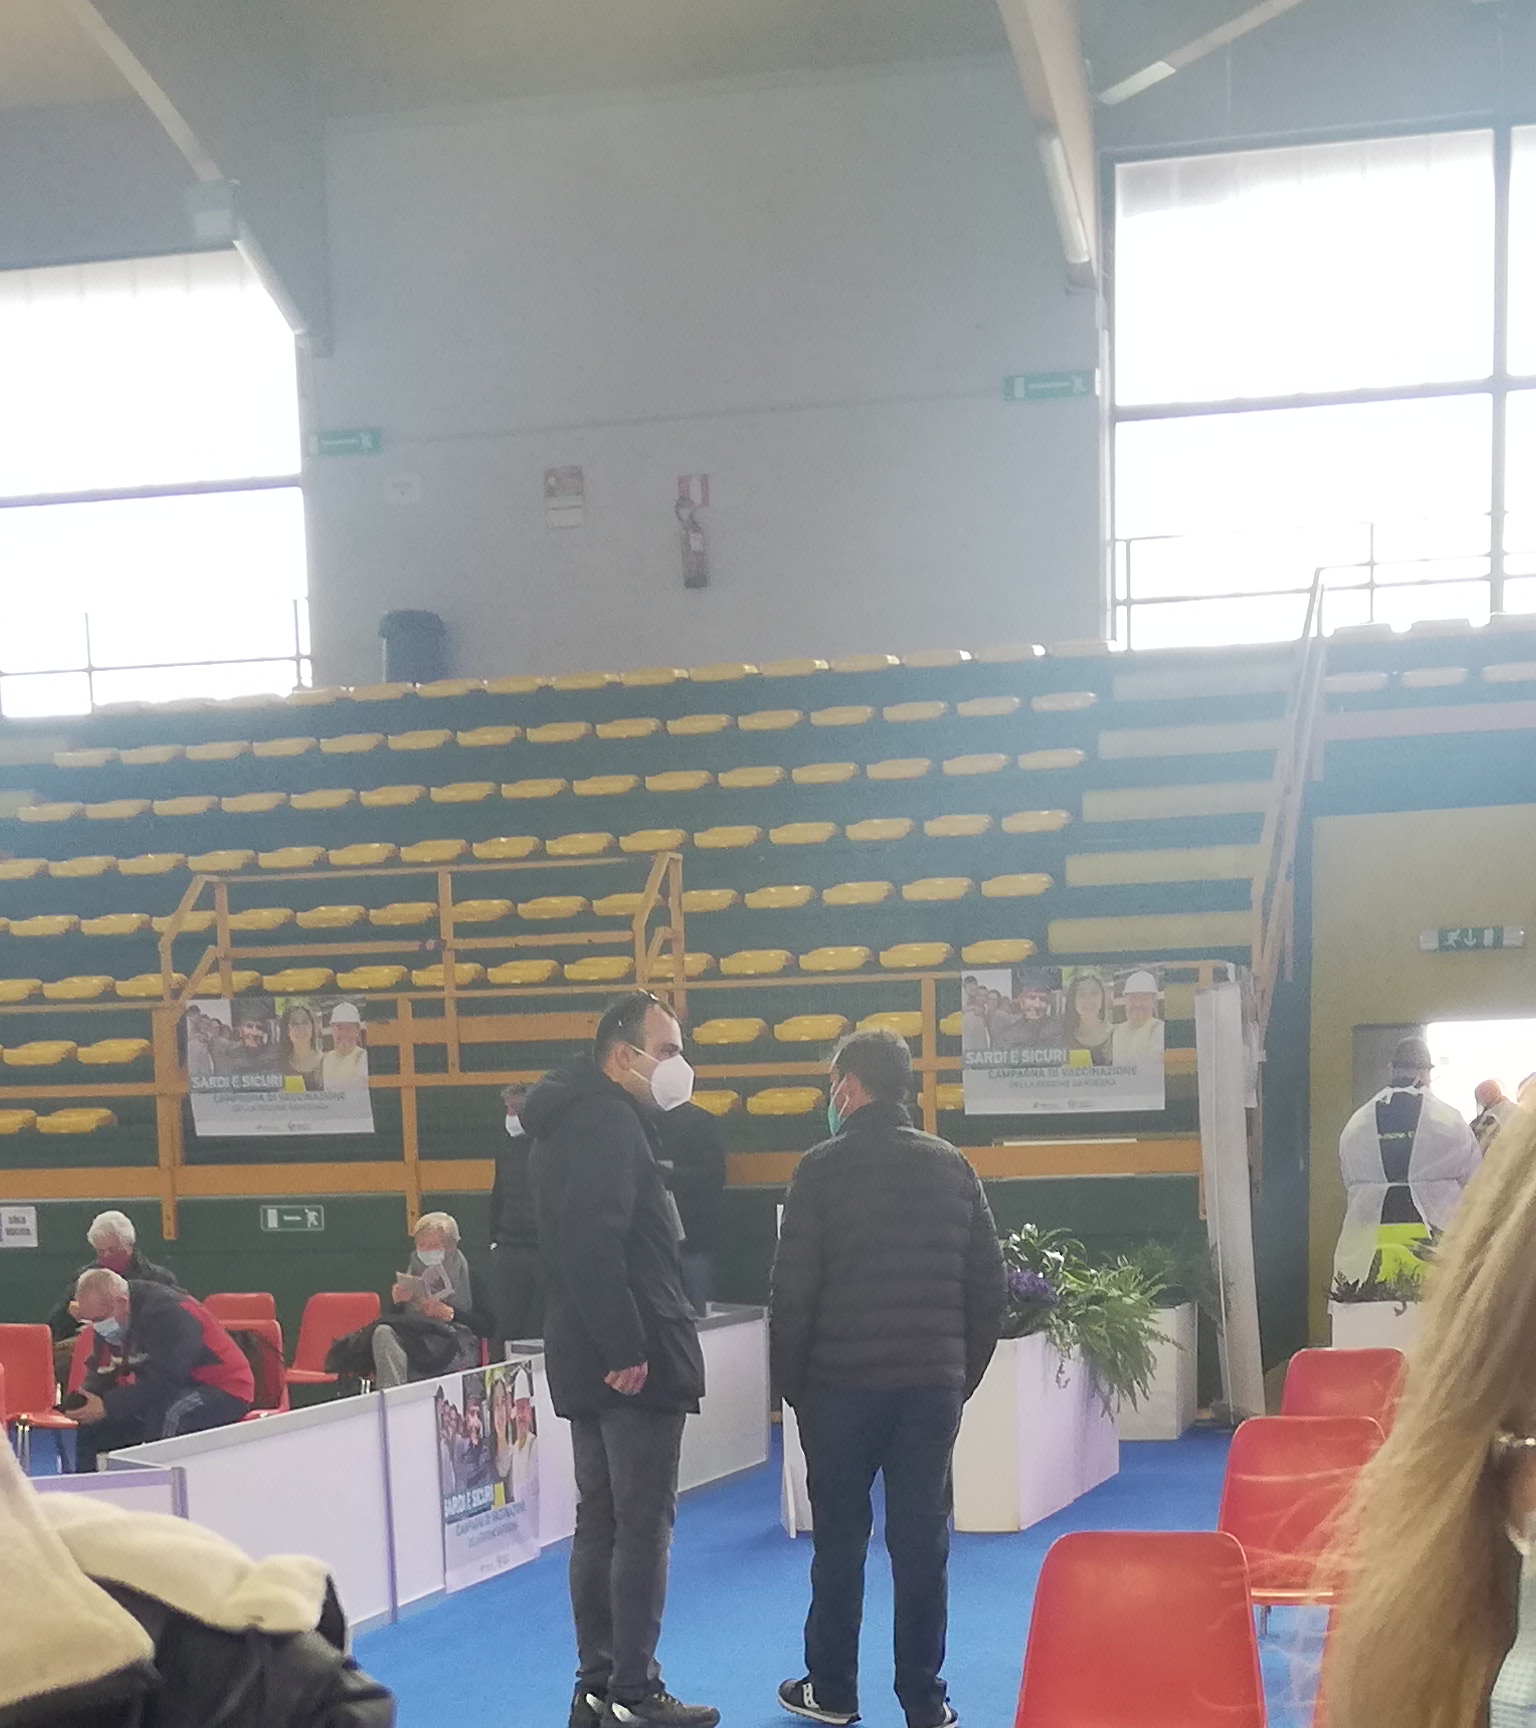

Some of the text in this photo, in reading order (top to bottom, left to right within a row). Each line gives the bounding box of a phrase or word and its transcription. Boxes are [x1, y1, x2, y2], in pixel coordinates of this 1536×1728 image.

[965, 1048, 1067, 1065] SARDI E SICURI
[988, 1065, 1137, 1079] CAMPAGNA DI VACCINAZIONE
[191, 1074, 283, 1089] SARDI E SICURI
[444, 1493, 466, 1518] SARDI
